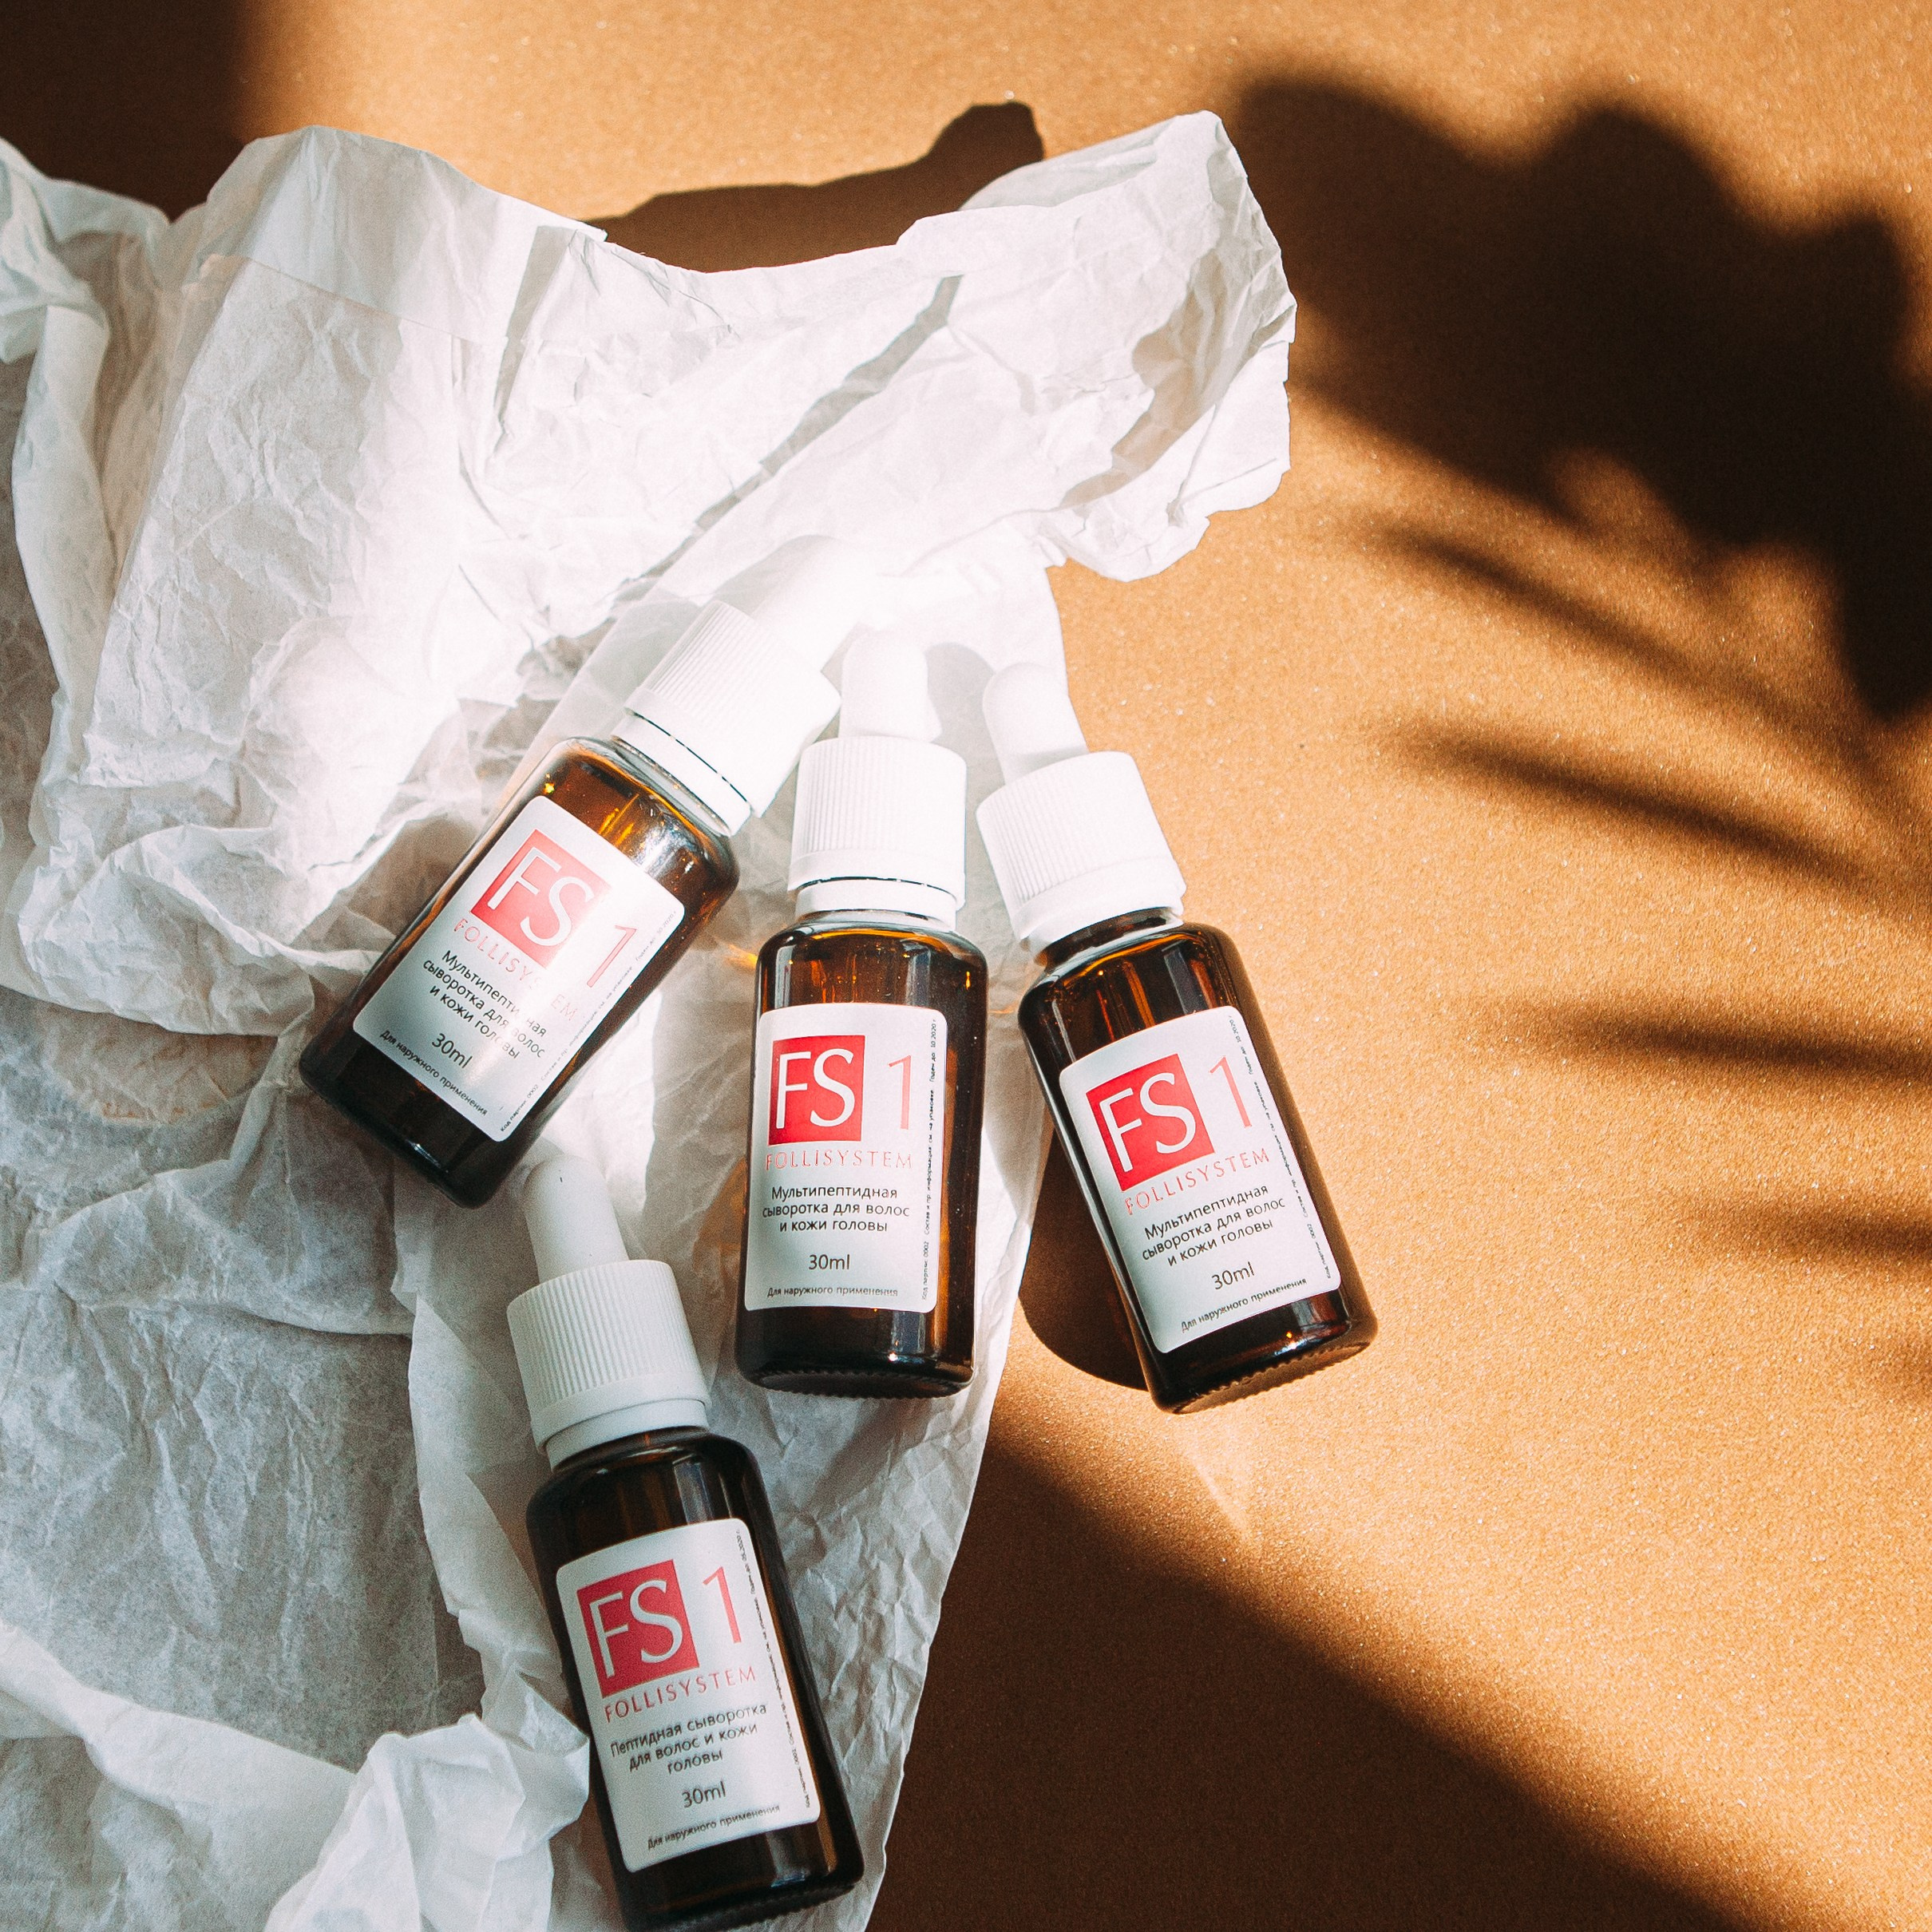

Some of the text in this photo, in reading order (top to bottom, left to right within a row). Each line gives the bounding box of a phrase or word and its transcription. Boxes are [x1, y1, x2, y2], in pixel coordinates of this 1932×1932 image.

[489, 847, 637, 988] FS 1
[423, 959, 485, 1009] сыворотка
[483, 1008, 508, 1029] для
[441, 950, 547, 1038] Мультипептиная
[453, 918, 579, 1022] FOLLISYSEM
[430, 985, 519, 1059] и кожи головы
[380, 1029, 487, 1116] Для наружного применения
[431, 1032, 473, 1069] 30ml
[776, 1048, 913, 1130] FS 1
[1099, 1056, 1253, 1172] FS 1
[766, 1150, 913, 1170] FOLLISYSTEM
[1125, 1148, 1270, 1215] FOLLISYSTEM
[762, 1203, 909, 1218] сыворотка для волос
[772, 1186, 897, 1201] Мультипептидная
[1145, 1185, 1268, 1241] Мультипептидная
[779, 1220, 887, 1232] и кожи головы
[1142, 1198, 1285, 1261] сыворотка для волос
[1167, 1219, 1273, 1266] и кожи головы
[809, 1254, 849, 1270] 30ml
[1212, 1262, 1255, 1290] 30ml
[767, 1286, 897, 1297] Для наружного применения
[1181, 1279, 1307, 1332] Для наружного применения
[589, 1566, 742, 1678] FS 1
[604, 1665, 756, 1724] FOLLISYSTEM
[611, 1704, 767, 1756] Пептидная сыворотка
[629, 1723, 758, 1772] для волос и кожи
[667, 1749, 723, 1775] головы
[682, 1782, 726, 1809] 30ml
[647, 1804, 780, 1850] Для наружного применения
